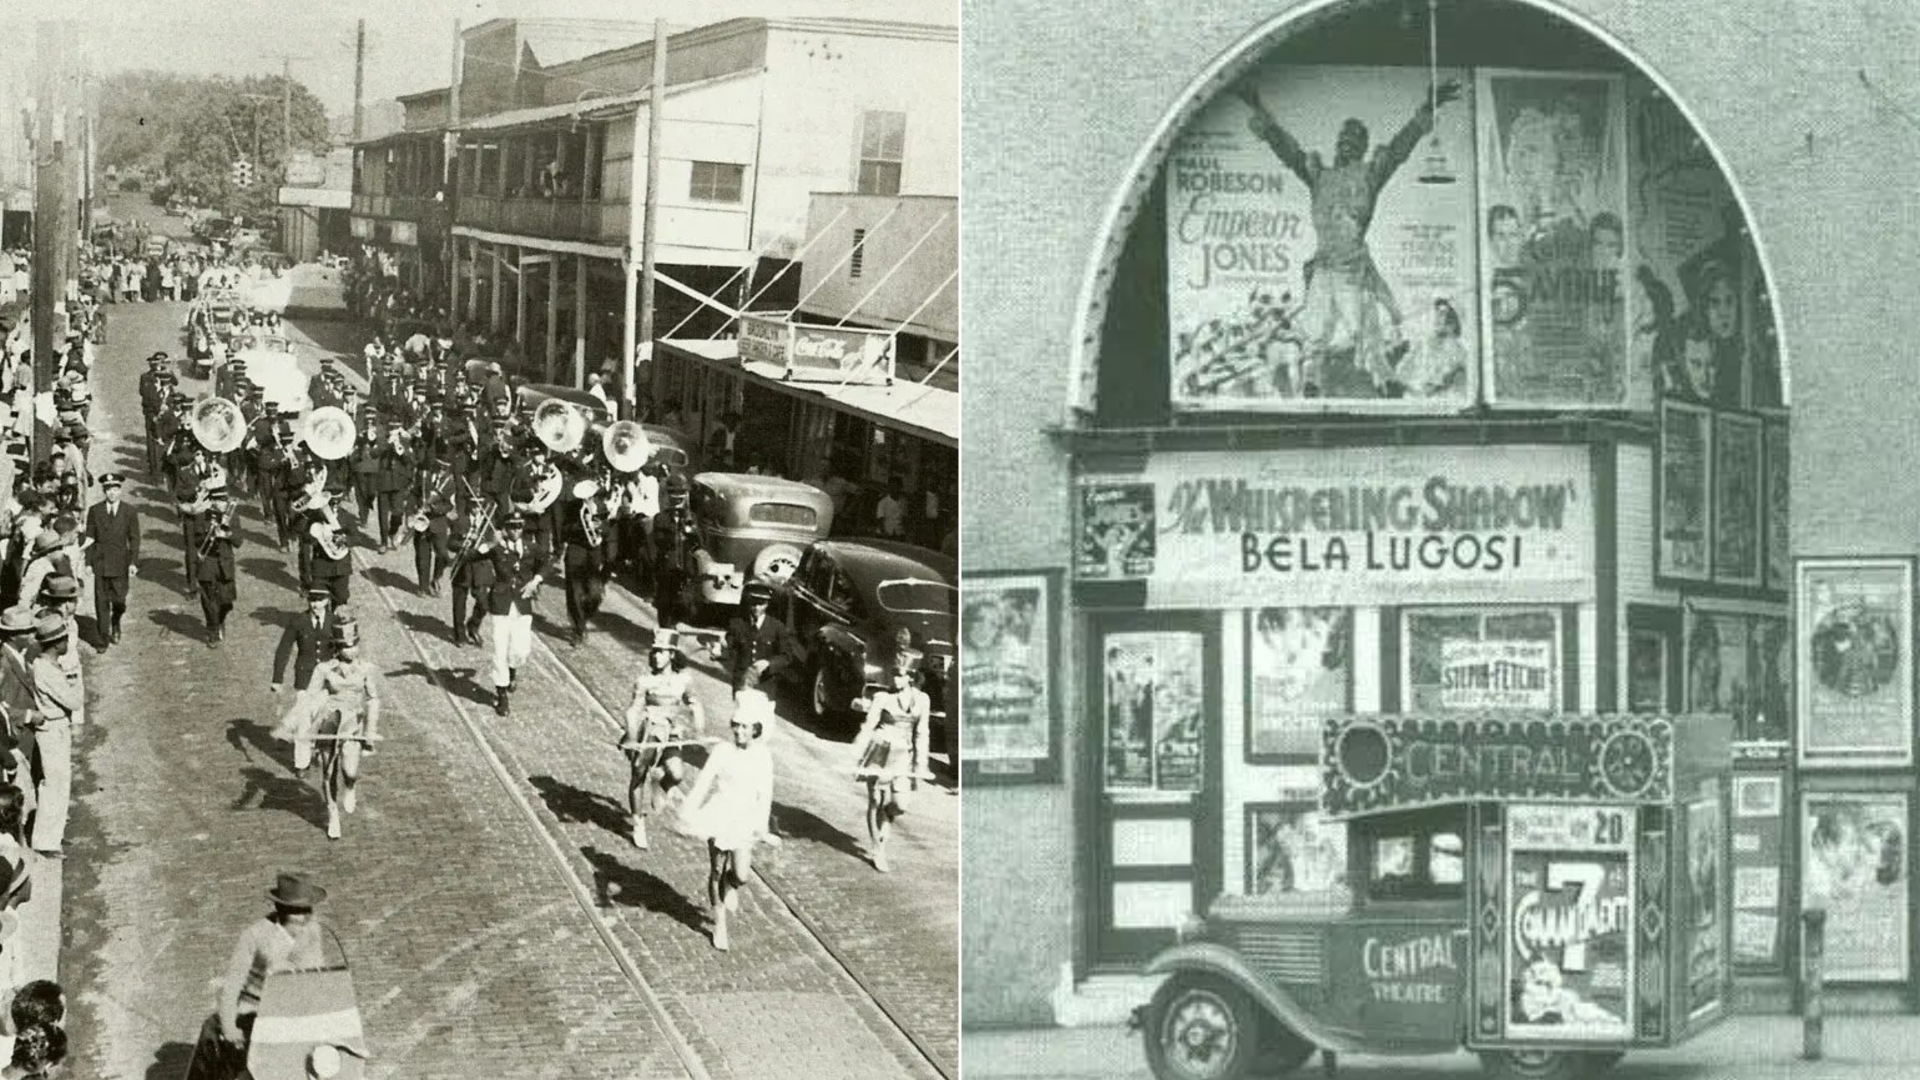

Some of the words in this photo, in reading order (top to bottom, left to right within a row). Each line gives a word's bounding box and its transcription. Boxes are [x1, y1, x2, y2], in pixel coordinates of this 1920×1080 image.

[1175, 157, 1223, 170] PAUL
[1177, 172, 1283, 193] ROBESON
[1188, 243, 1290, 289] JONES
[1241, 532, 1350, 573] BELA
[1366, 529, 1522, 571] LUGOSI
[1406, 740, 1581, 786] CENTRAL
[1594, 810, 1622, 845] 20
[1363, 934, 1457, 978] CENTRAL
